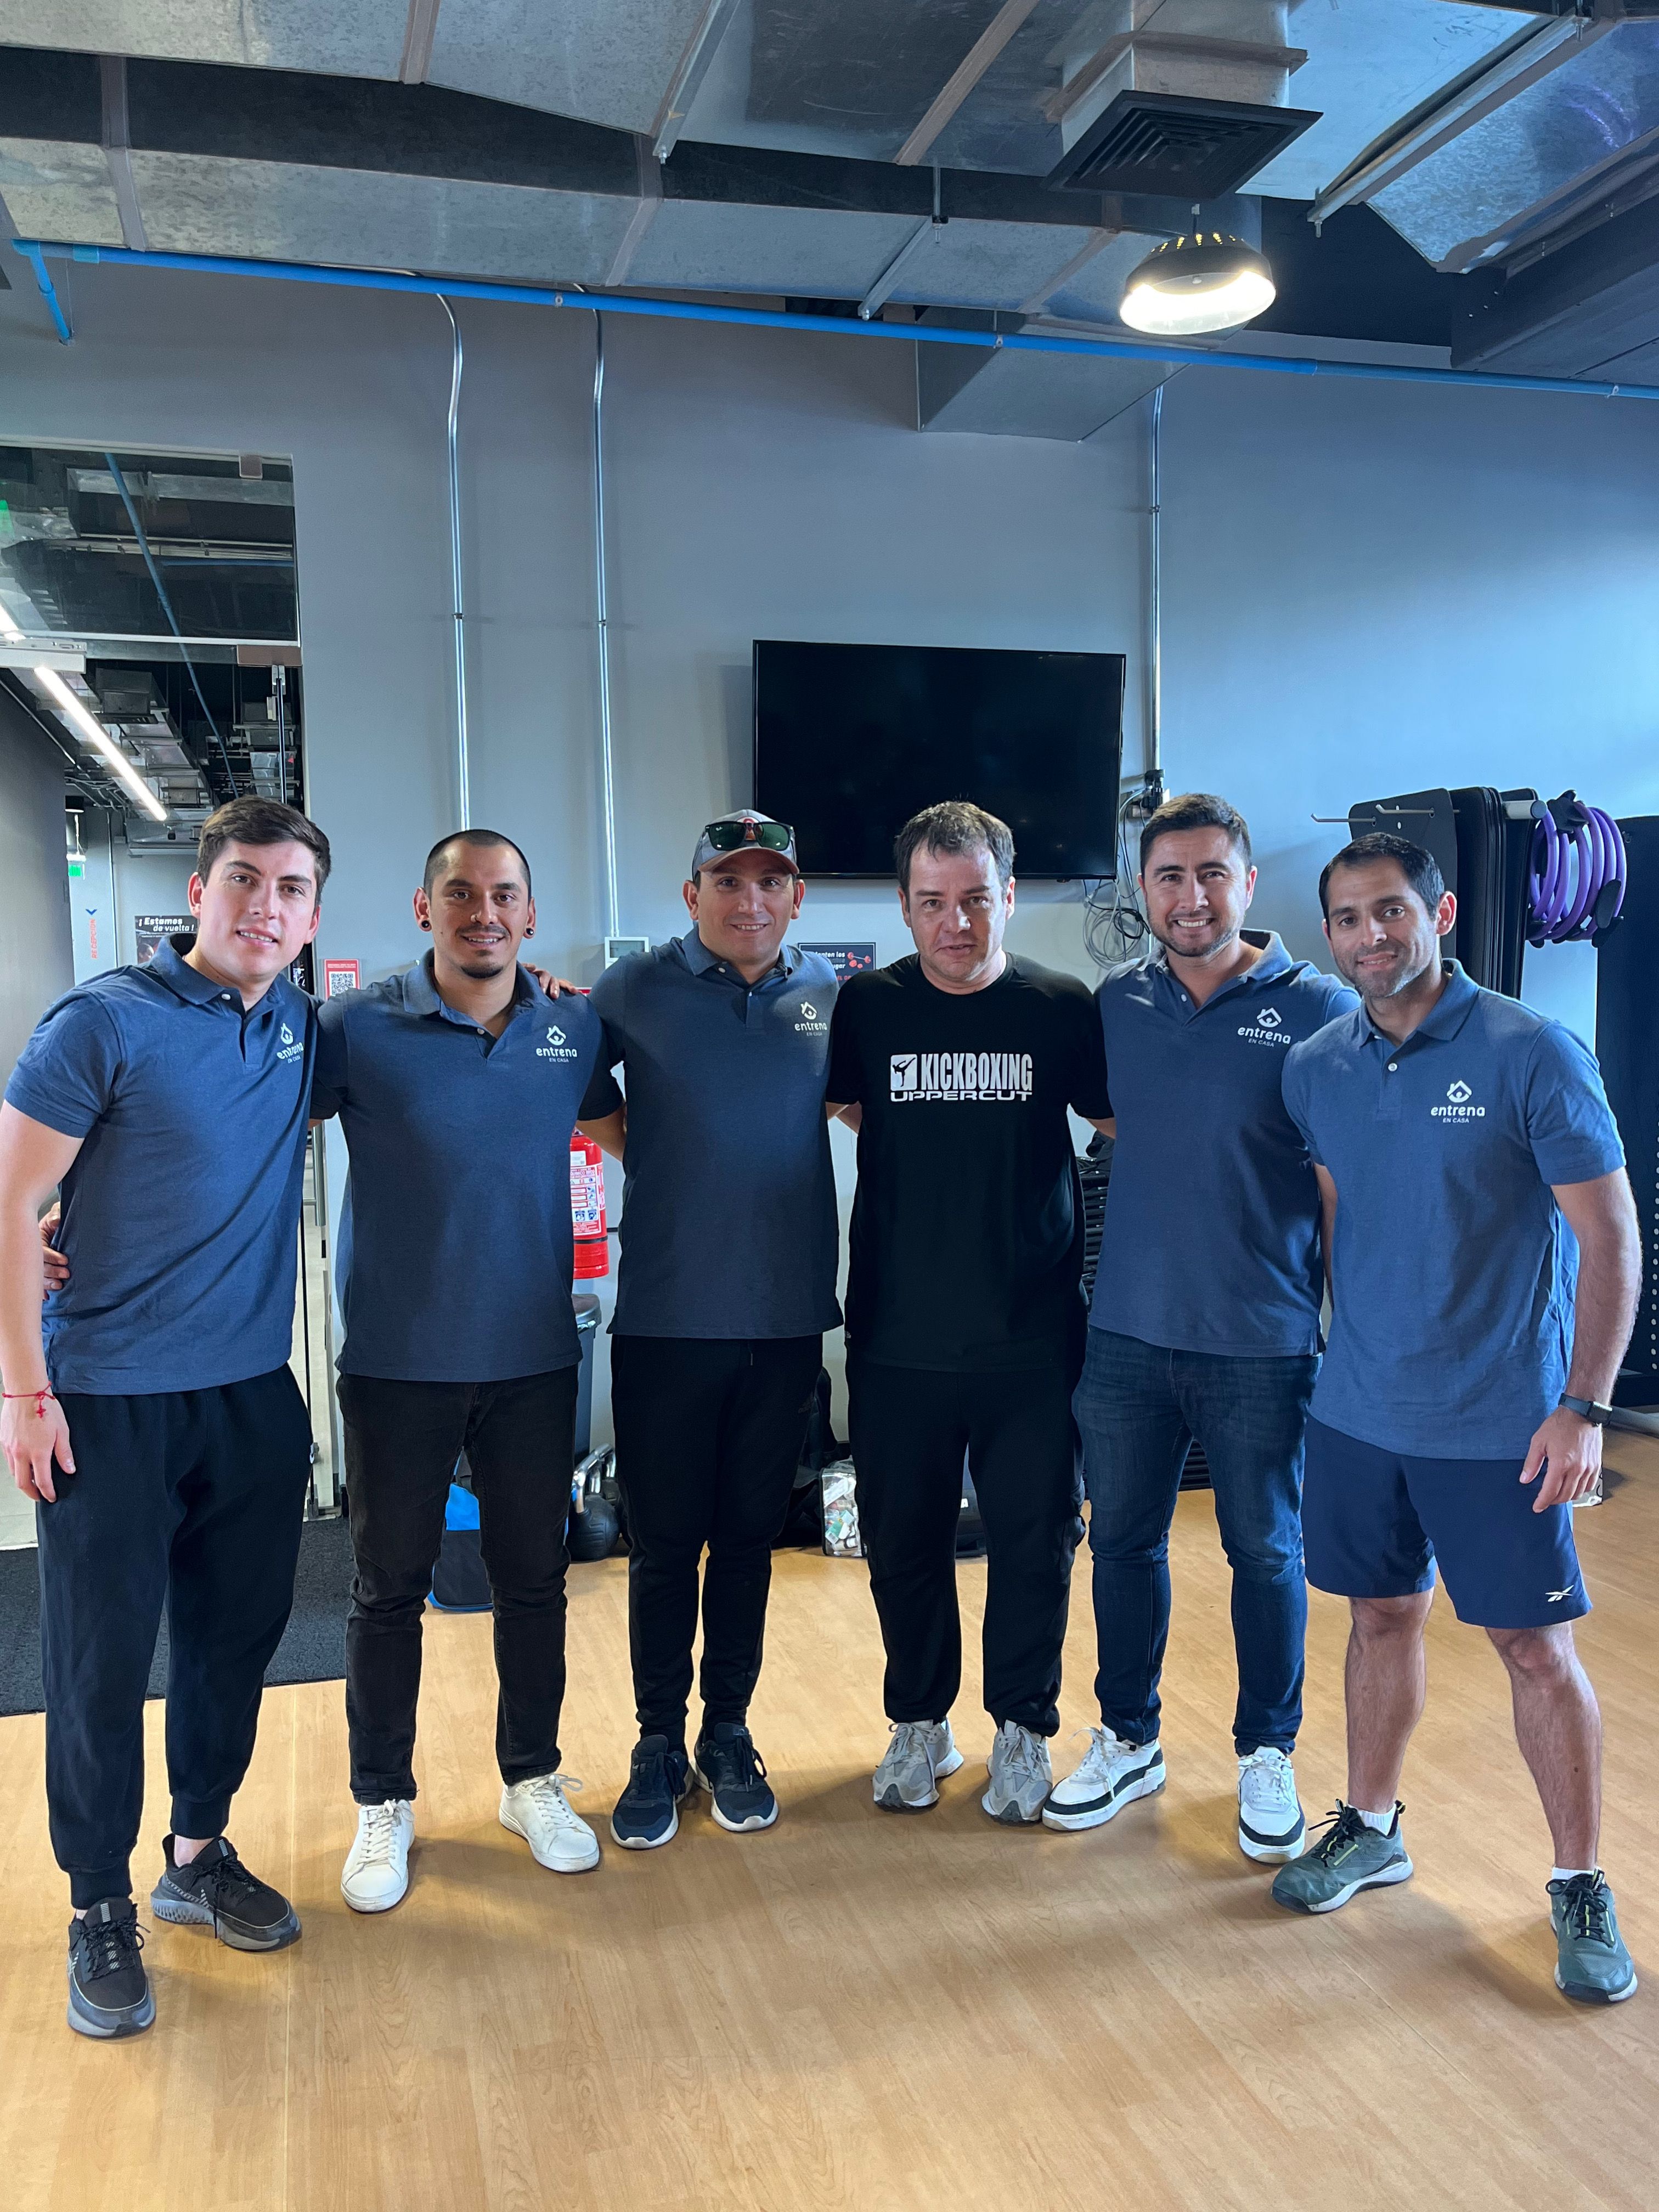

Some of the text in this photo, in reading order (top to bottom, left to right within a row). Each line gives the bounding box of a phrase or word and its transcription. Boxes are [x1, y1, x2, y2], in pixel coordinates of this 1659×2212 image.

[794, 1022, 827, 1031] entrena
[1237, 1027, 1291, 1045] entrena
[536, 1047, 578, 1057] entrena
[921, 1052, 1033, 1091] KICKBOXING
[890, 1090, 1033, 1102] UPPERCUT
[1431, 1105, 1486, 1116] entrena
